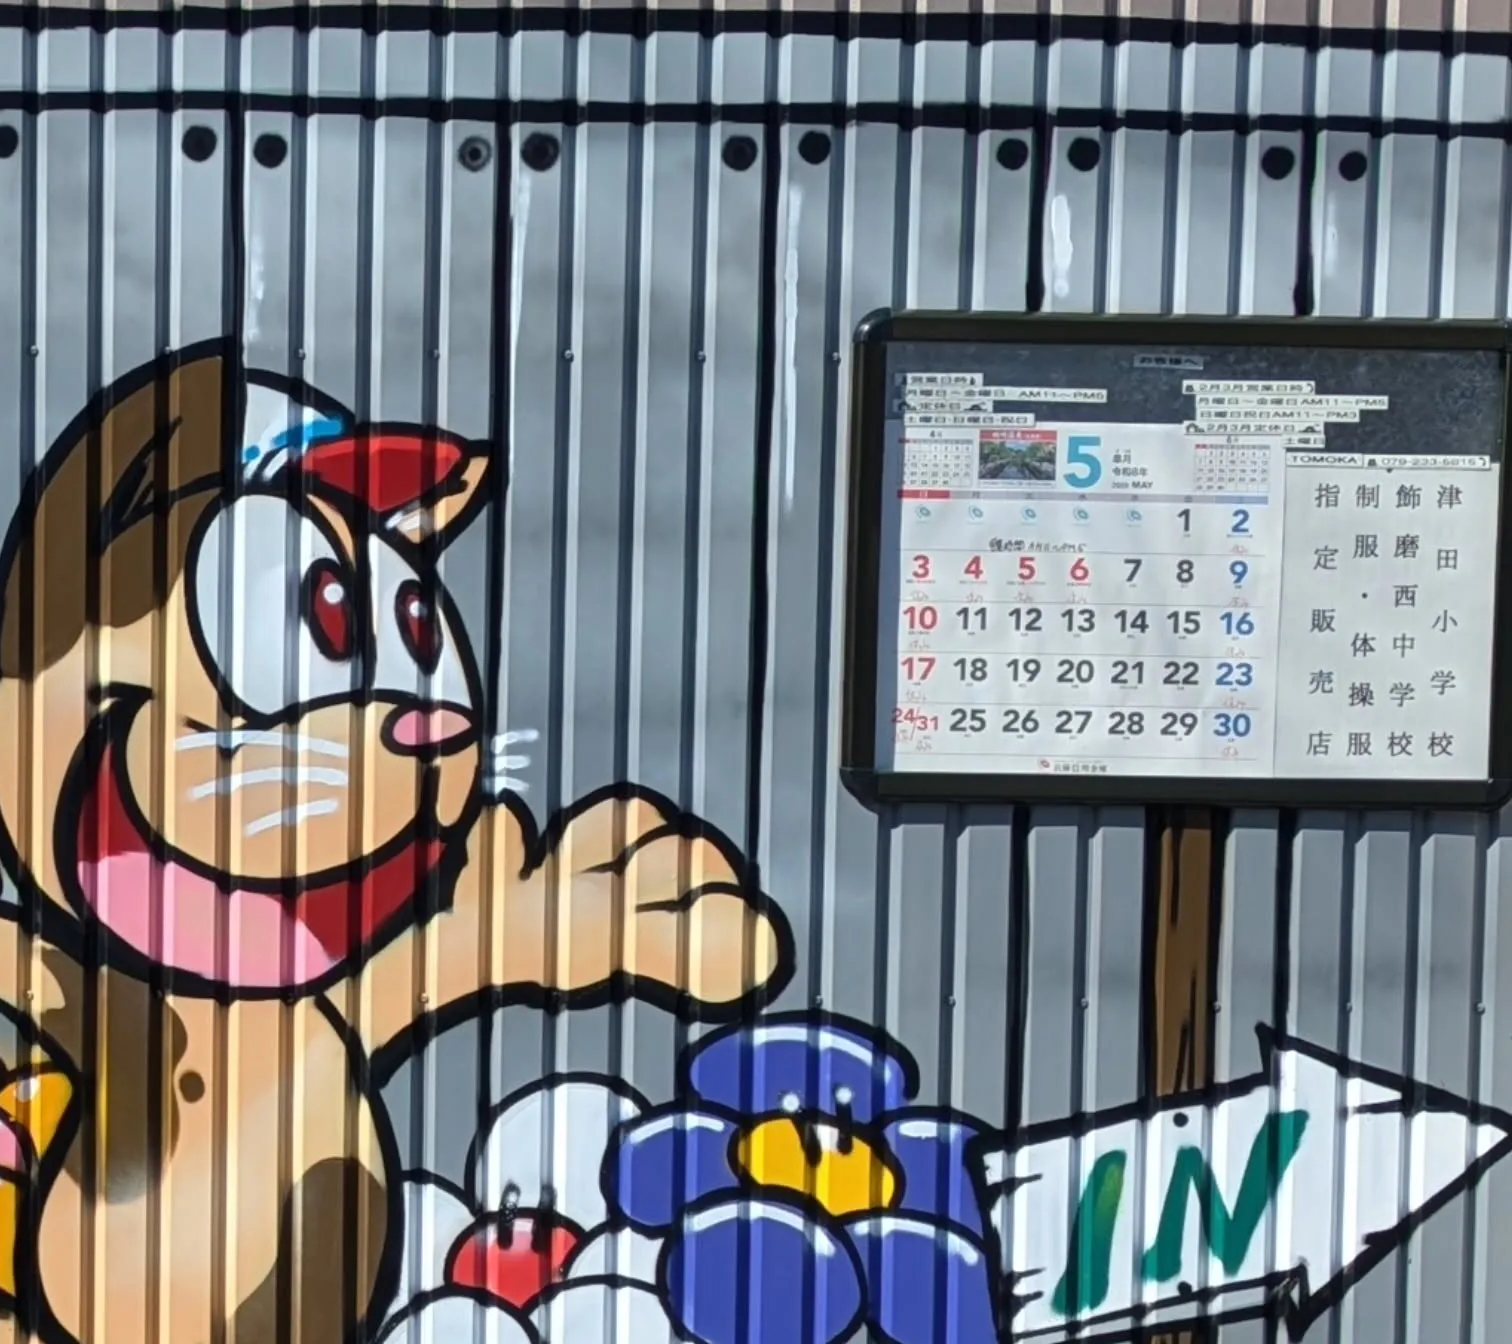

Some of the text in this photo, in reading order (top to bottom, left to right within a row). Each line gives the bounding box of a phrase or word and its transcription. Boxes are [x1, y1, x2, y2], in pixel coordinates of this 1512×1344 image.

[1062, 436, 1102, 489] 5
[1292, 455, 1358, 465] TOMOKA
[1131, 480, 1154, 489] MAY
[1177, 508, 1250, 533] 1 2
[912, 554, 1248, 584] 3 4 5 6 7 8 9
[903, 606, 1254, 635] 10 11 12 13 14 15 16
[1306, 483, 1340, 756] 指定販売店
[1346, 484, 1381, 757] 制服・体操服
[1386, 484, 1423, 757] 飾磨西中学校
[1427, 484, 1463, 757] 津田小学校
[901, 656, 1253, 687] 17 18 19 20 21 22 23
[949, 708, 986, 733] 25
[1002, 709, 1039, 733] 26
[1055, 710, 1093, 734] 27
[1108, 711, 1144, 735] 28
[1160, 712, 1198, 736] 29
[1213, 712, 1251, 738] 30
[1050, 1108, 1310, 1316] IN
